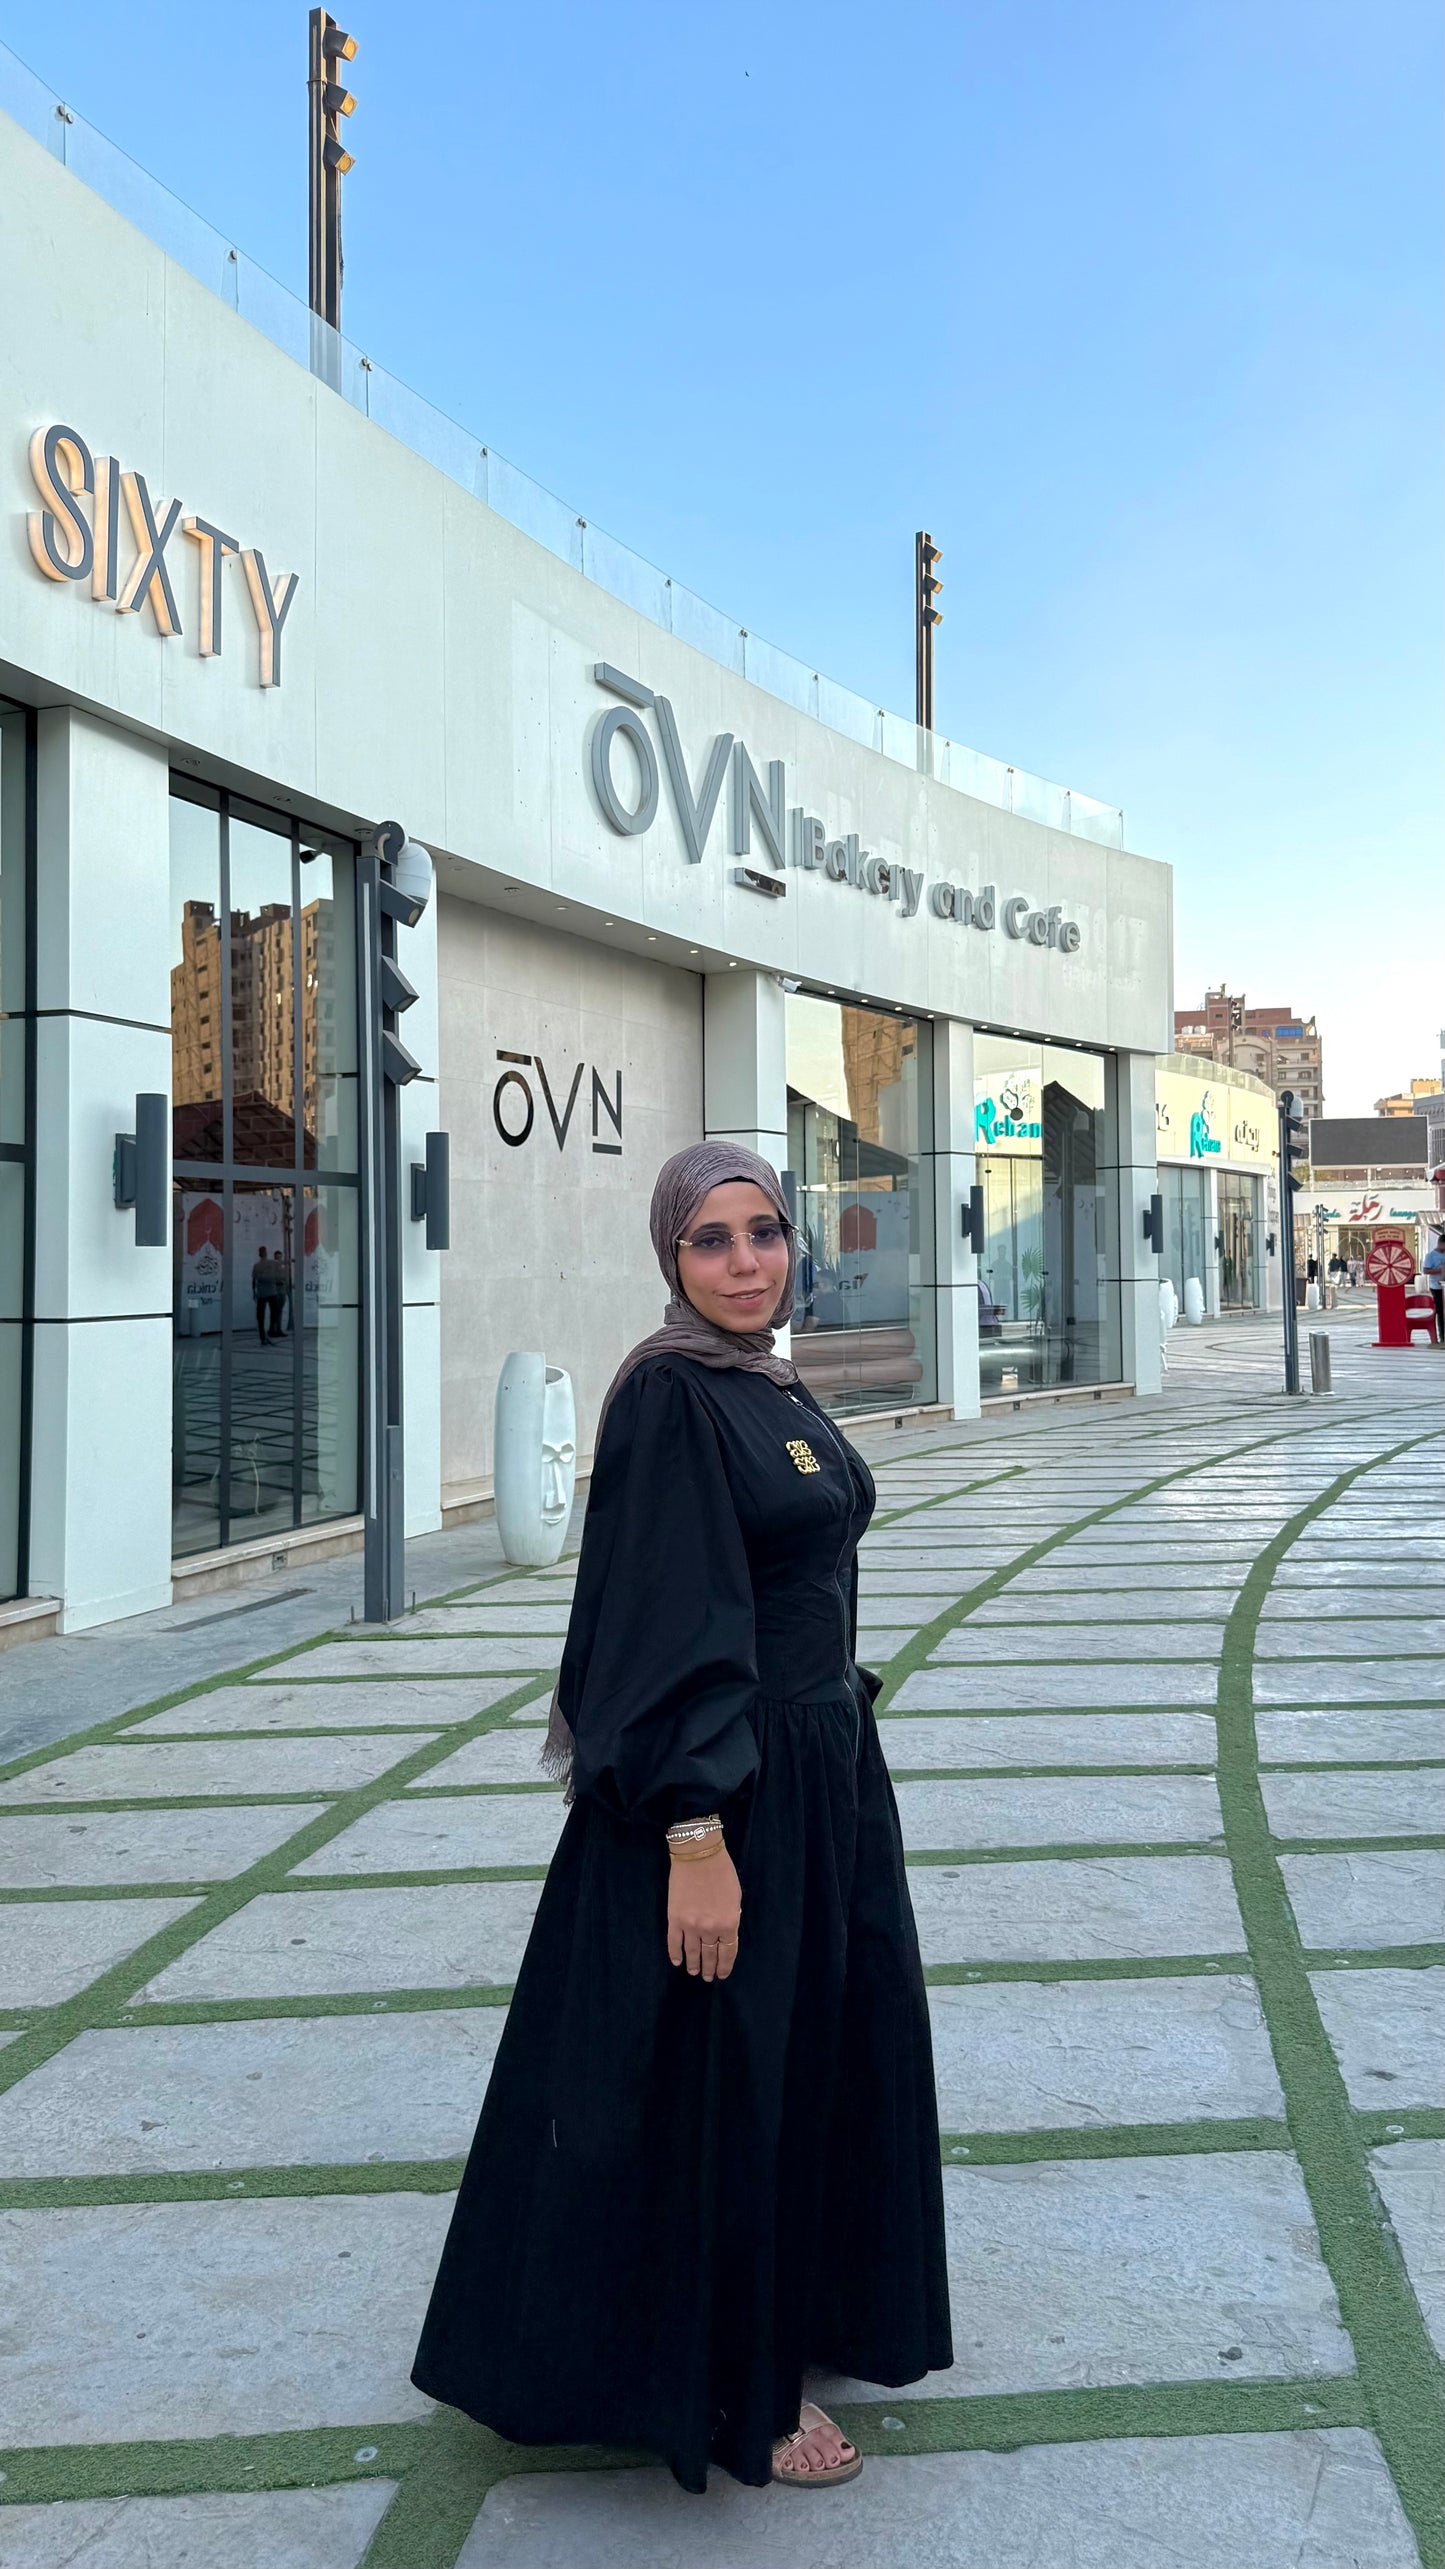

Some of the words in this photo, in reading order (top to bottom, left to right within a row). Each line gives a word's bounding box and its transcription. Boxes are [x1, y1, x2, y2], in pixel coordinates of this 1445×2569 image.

[27, 424, 299, 688] SIXTY
[803, 816, 924, 917] Bakery
[933, 884, 995, 930] and
[1005, 896, 1081, 952] Cafe
